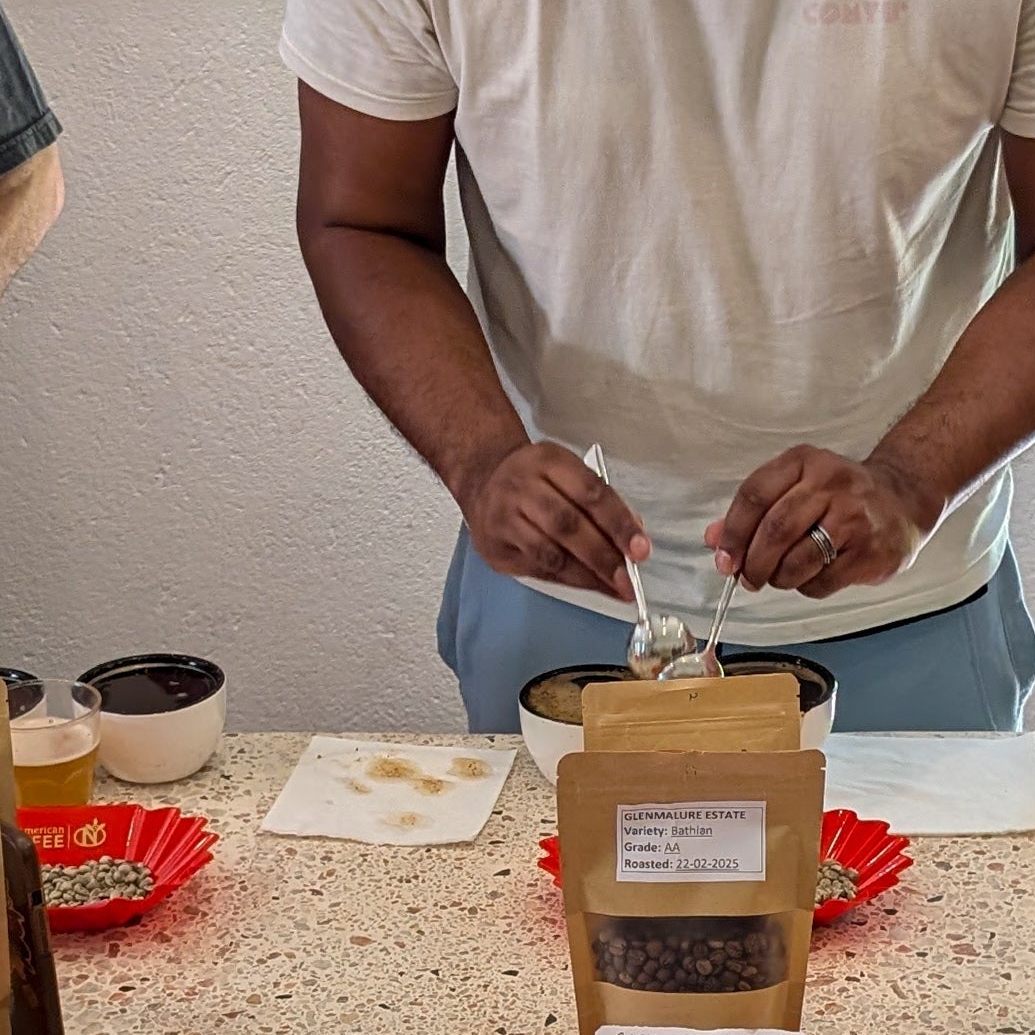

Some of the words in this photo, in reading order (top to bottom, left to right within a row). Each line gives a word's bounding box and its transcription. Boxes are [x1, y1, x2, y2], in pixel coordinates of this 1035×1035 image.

[624, 811, 702, 821] GLENMALURE
[705, 810, 746, 820] ESTATE
[624, 826, 668, 837] Variety:
[624, 842, 661, 852] Grade:
[664, 842, 681, 853] AA
[624, 858, 673, 869] Roasted:
[676, 858, 739, 870] 22-02-2025
